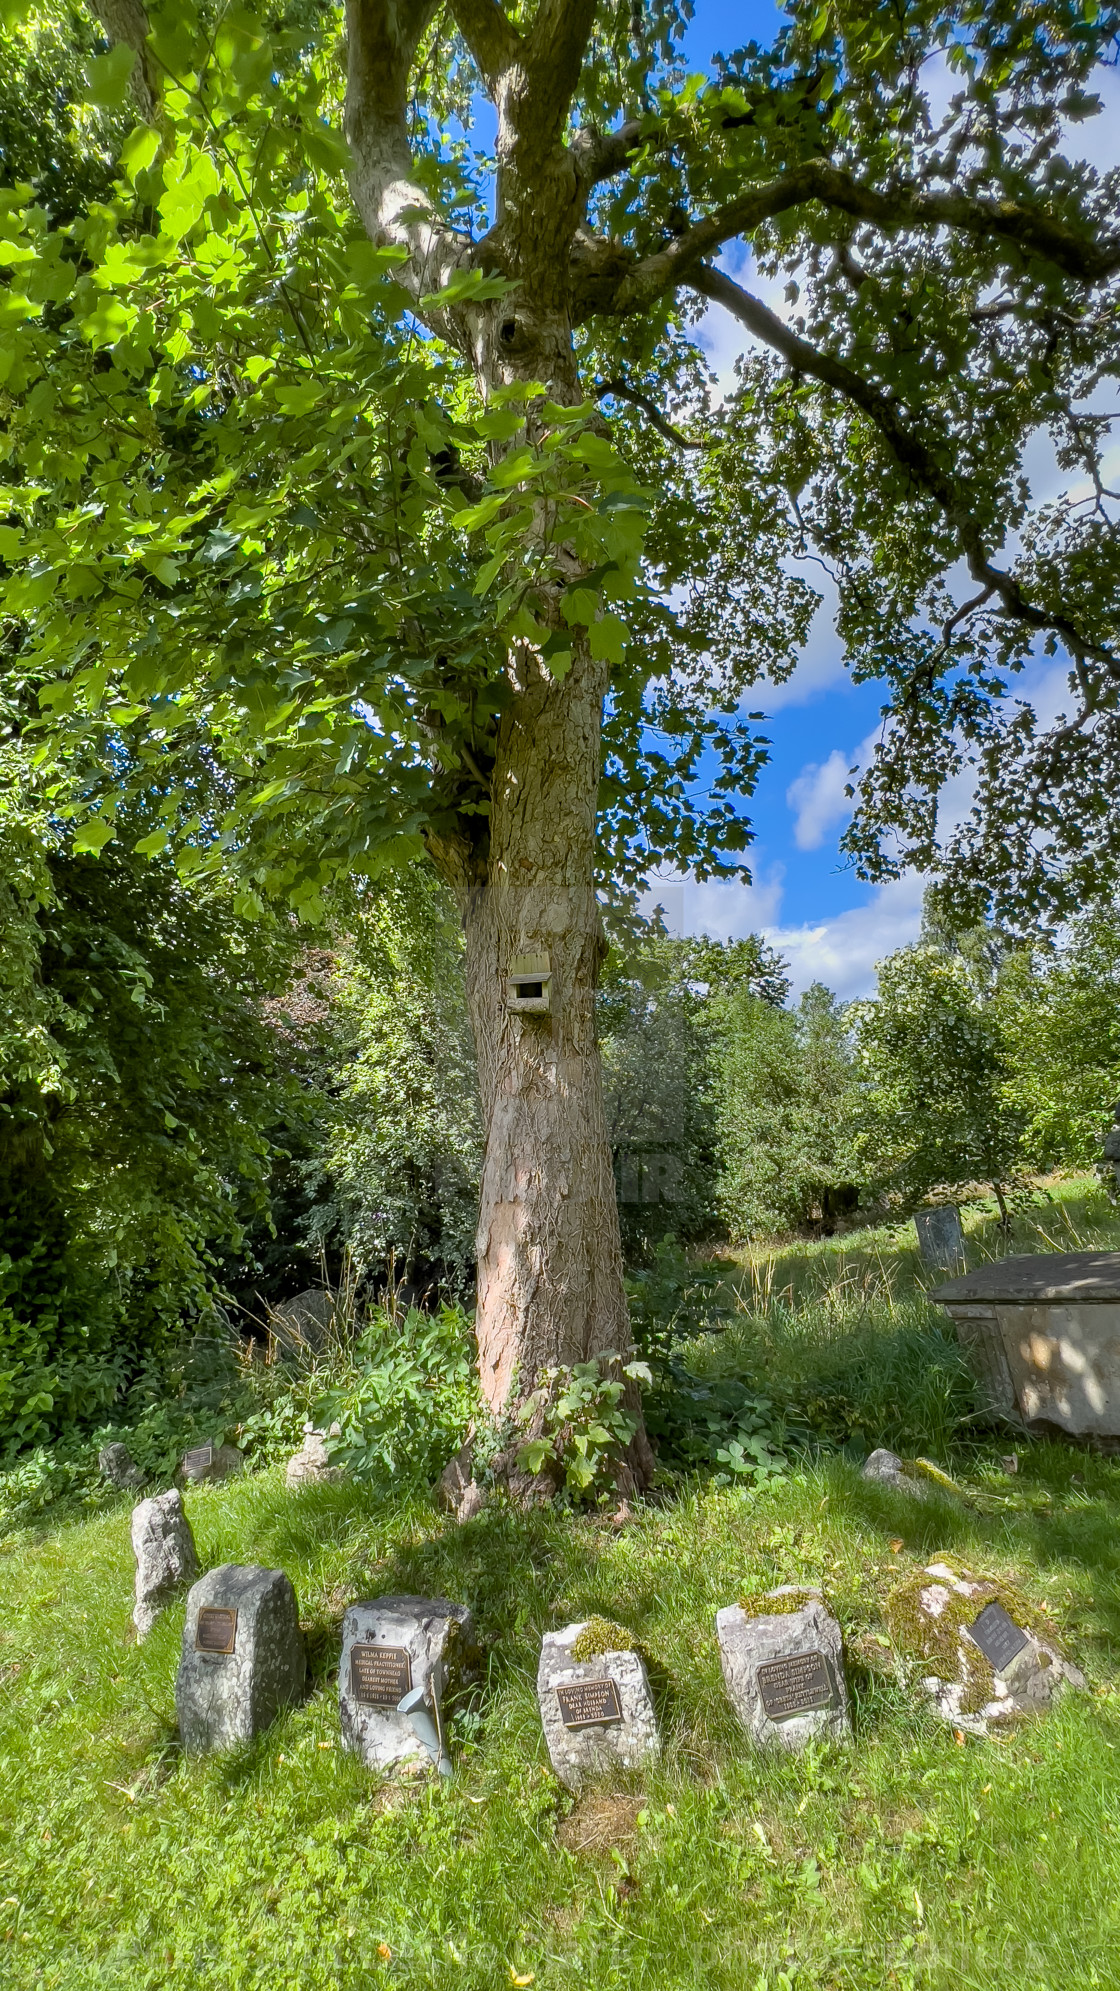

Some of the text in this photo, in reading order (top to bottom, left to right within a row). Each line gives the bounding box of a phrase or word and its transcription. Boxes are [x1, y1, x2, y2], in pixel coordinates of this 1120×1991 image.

[379, 1652, 397, 1660] KEPPIE
[769, 1664, 788, 1673] LOVING
[789, 1657, 810, 1668] MEMORY
[761, 1662, 821, 1685] BRENDA SIMPSON
[774, 1680, 789, 1689] DEAR
[790, 1676, 805, 1685] WIFE
[565, 1687, 583, 1695] LOVING
[583, 1684, 604, 1692] MEMORY
[785, 1683, 805, 1694] FRANK
[562, 1690, 610, 1703] FRANK SIMPSON
[569, 1699, 607, 1710] DEAR HUSBAND
[766, 1699, 774, 1707] OF
[584, 1705, 603, 1713] BRENDA
